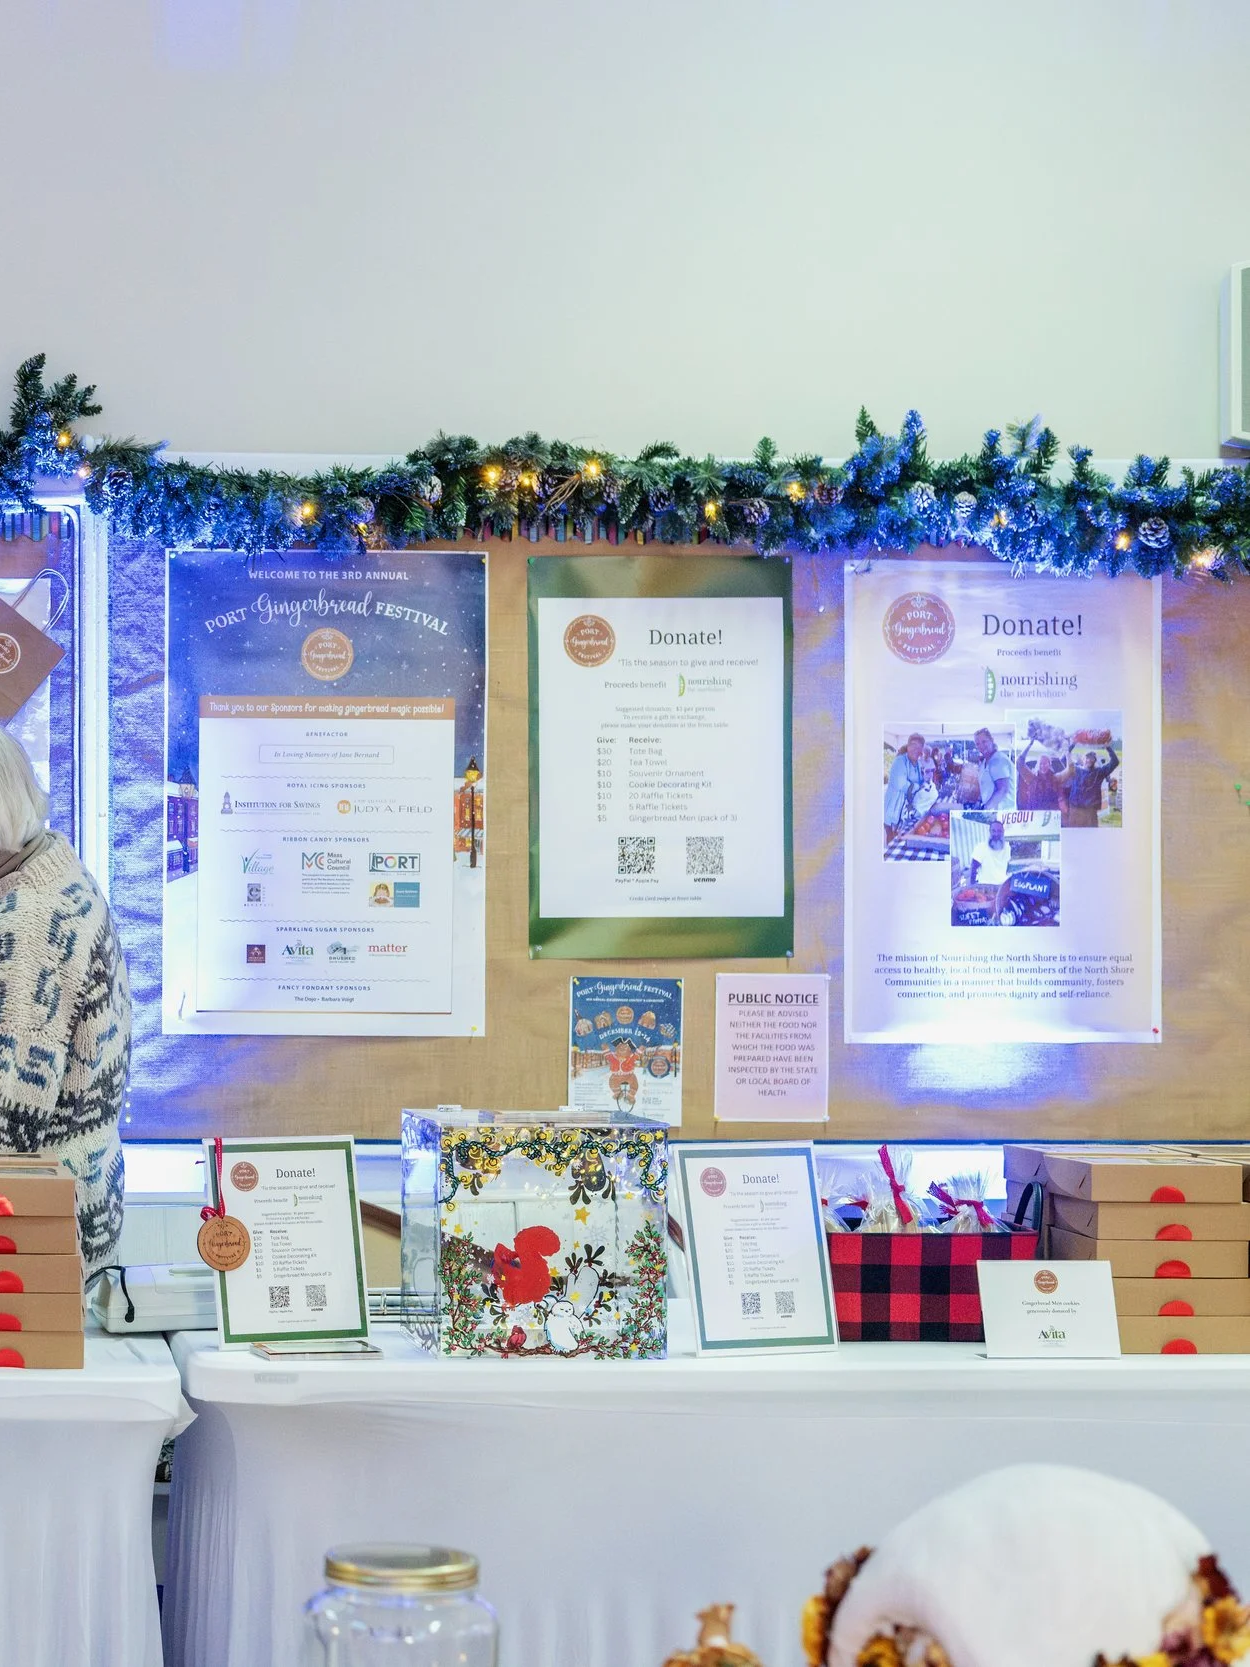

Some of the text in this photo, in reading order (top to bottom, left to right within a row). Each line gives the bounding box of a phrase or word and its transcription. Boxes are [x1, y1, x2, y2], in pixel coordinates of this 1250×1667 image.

[249, 570, 409, 581] WELCOME TO THE 3RD ANNUAL
[205, 588, 450, 636] PORT Gingerbread FESTIVAL
[906, 610, 934, 620] PORT
[981, 614, 1082, 636] Donate!
[649, 629, 723, 646] Donate!
[997, 648, 1062, 657] Proceeds benefit
[634, 658, 648, 666] the
[690, 658, 707, 668] give
[709, 658, 724, 666] and
[726, 658, 759, 666] receive!
[604, 680, 667, 689] Proceeds benefit
[687, 676, 732, 687] nourishing
[1001, 671, 1078, 691] nourishing
[1000, 688, 1014, 698] the
[210, 702, 230, 711] Thank
[231, 704, 246, 715] you
[246, 703, 254, 711] to
[271, 703, 303, 714] Sponsors
[305, 703, 317, 712] for
[319, 704, 343, 716] making
[345, 704, 389, 716] gingerbread
[391, 704, 411, 716] magic
[413, 704, 445, 716] possible!
[628, 736, 662, 744] Receive:
[657, 781, 699, 790] Decorating
[354, 805, 380, 813] JUDY
[398, 805, 433, 813] FIELD
[375, 856, 418, 869] PORT
[1013, 879, 1048, 893] EGGPLANT
[282, 944, 315, 956] Avita
[368, 943, 408, 953] matter
[876, 954, 893, 962] The
[895, 954, 928, 962] mission
[930, 954, 939, 962] of
[990, 954, 1004, 962] the
[1006, 954, 1031, 962] North
[1032, 954, 1058, 962] Shore
[1059, 954, 1067, 962] is
[1109, 954, 1133, 964] equal
[728, 993, 819, 1004] PUBLIC NOTICE
[728, 1066, 818, 1074] INSPECTED BY THE STATE
[758, 1089, 786, 1097] HEALTH
[276, 1168, 316, 1179] Donate!
[742, 1174, 780, 1185] Donate!
